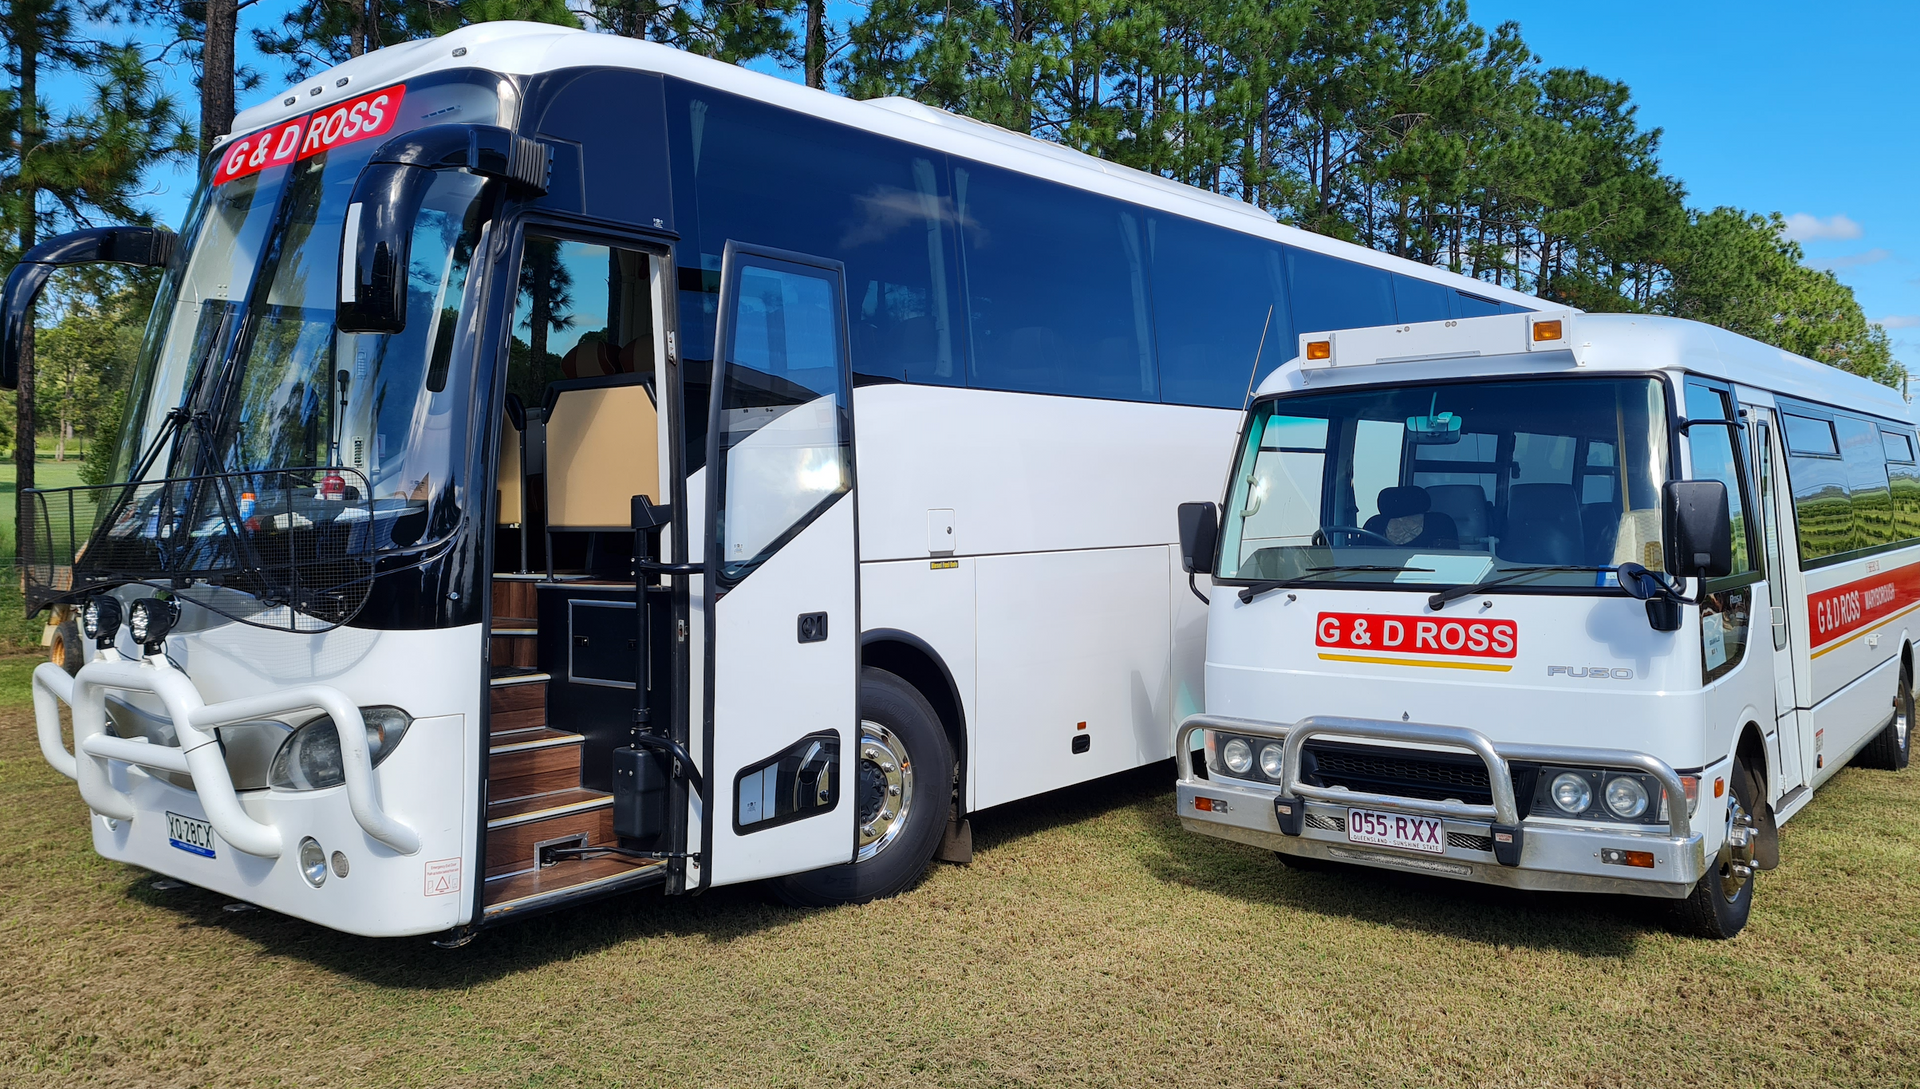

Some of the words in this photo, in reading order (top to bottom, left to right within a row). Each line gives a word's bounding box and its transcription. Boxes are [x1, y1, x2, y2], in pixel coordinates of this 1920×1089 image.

[226, 141, 249, 175] G
[249, 133, 272, 167] &
[273, 124, 300, 160] D
[301, 95, 389, 153] ROSS
[1817, 601, 1825, 633] G
[1826, 599, 1833, 631] &
[1833, 597, 1840, 628] D
[1840, 590, 1860, 625] ROSS
[1318, 617, 1341, 643] G
[1350, 619, 1372, 646] &
[1383, 620, 1405, 647] D
[1416, 622, 1514, 653] ROSS
[1547, 665, 1634, 680] FUSO
[1353, 835, 1388, 844] QUEENSLAND
[1393, 840, 1420, 848] SUNSHINE
